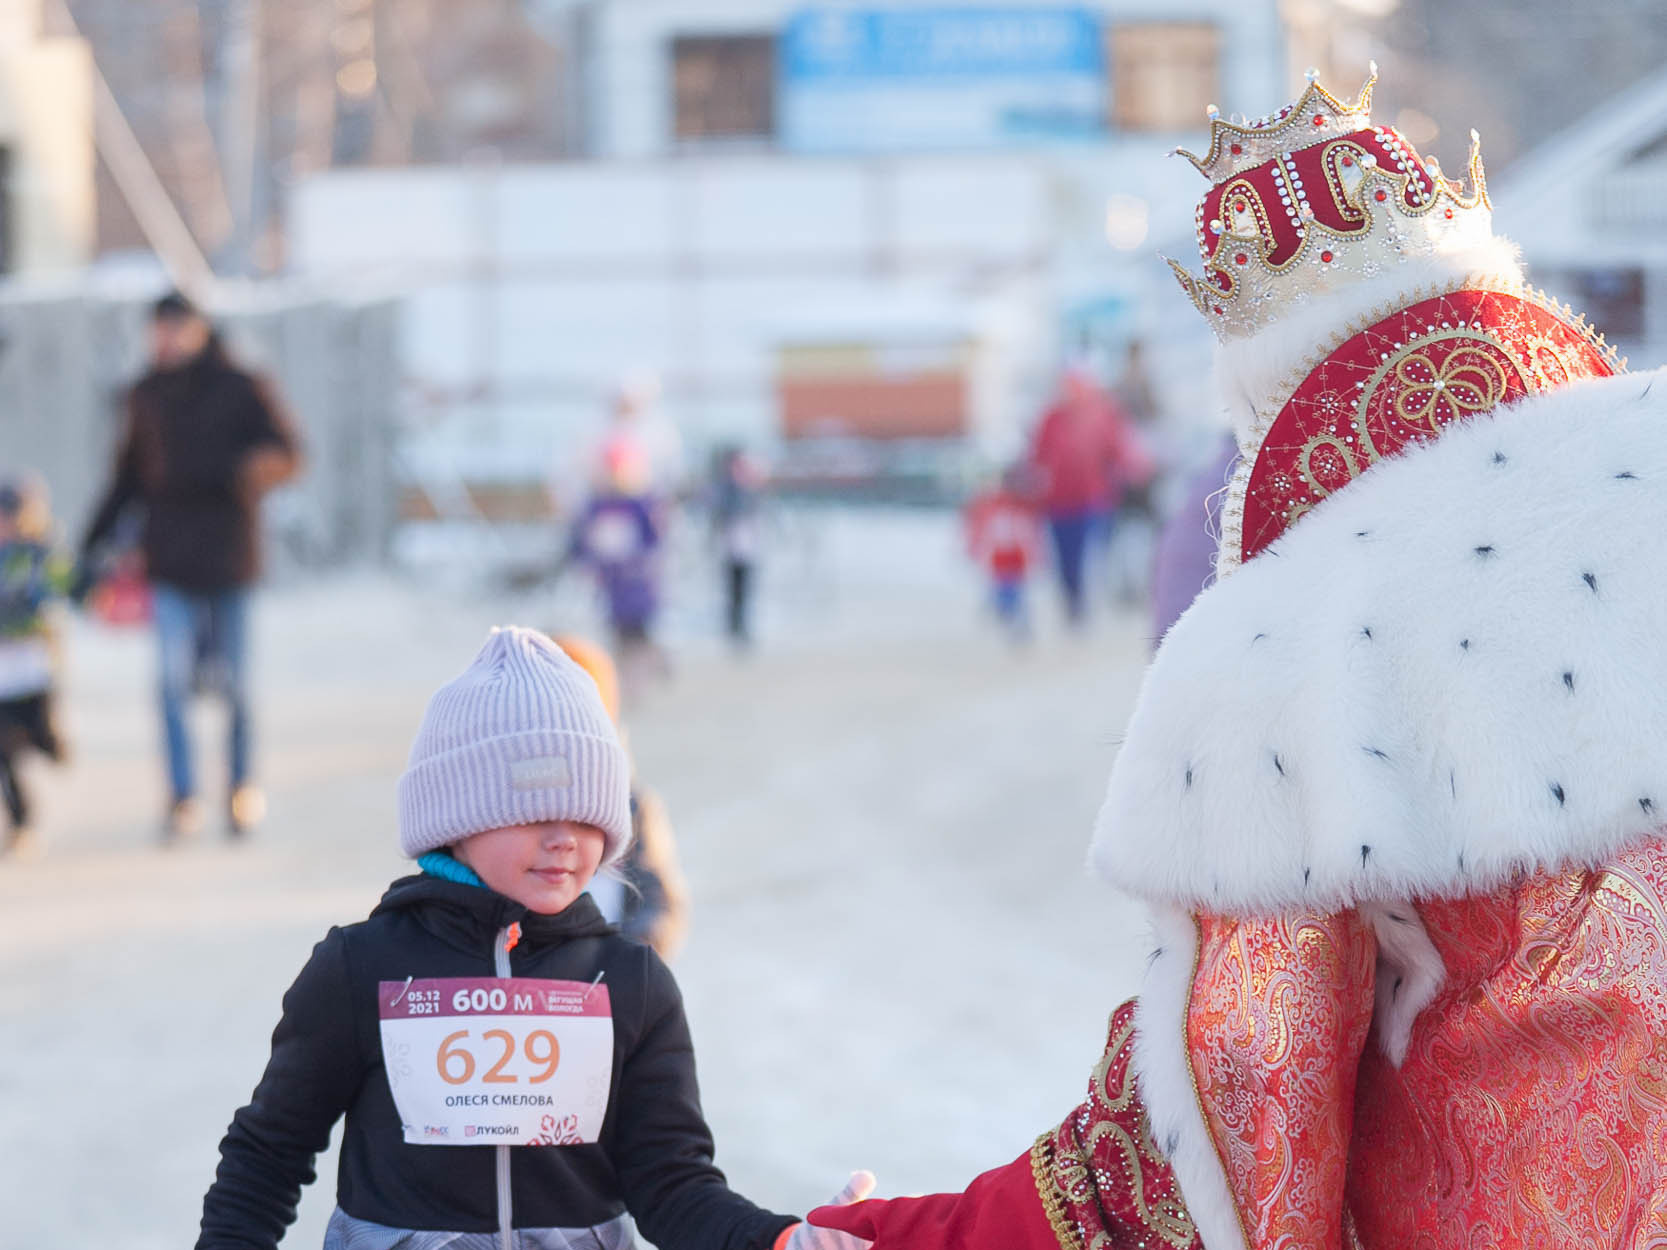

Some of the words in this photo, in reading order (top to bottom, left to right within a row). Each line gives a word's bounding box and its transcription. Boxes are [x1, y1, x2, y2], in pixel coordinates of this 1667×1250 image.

[408, 991, 441, 1002] 05.12
[452, 988, 507, 1012] 600
[408, 1002, 440, 1014] 2021
[436, 1029, 561, 1085] 629
[445, 1095, 488, 1107] ОЛЕСЯ
[492, 1094, 554, 1107] СМЕЛОВА
[476, 1123, 520, 1136] ЛУКОЙЛ
